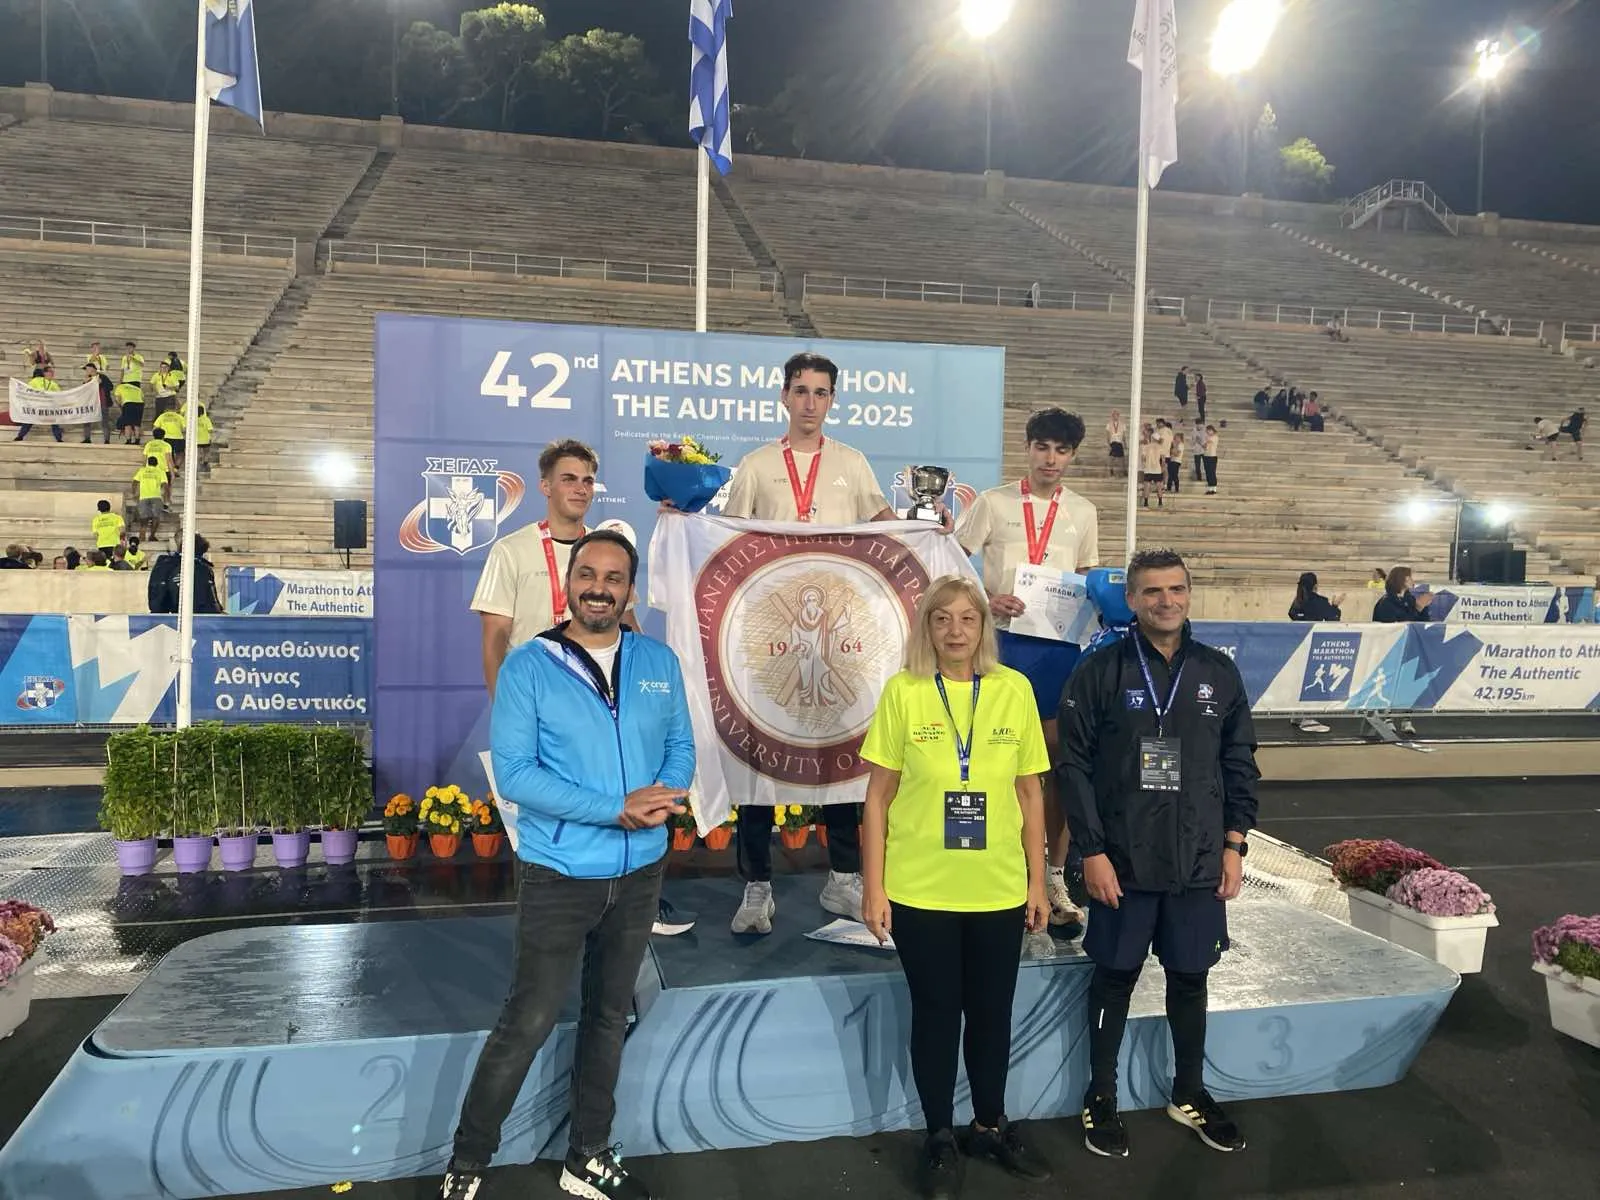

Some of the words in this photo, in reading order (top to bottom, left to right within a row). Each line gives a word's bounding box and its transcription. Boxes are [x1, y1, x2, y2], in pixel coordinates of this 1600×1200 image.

[611, 358, 732, 387] ATHENS
[740, 364, 915, 394] MAHON.
[38, 408, 73, 416] RUNNING
[612, 393, 670, 418] THE
[677, 396, 840, 425] AUTHENC
[847, 403, 913, 427] 2025
[614, 429, 650, 438] Dedicated
[425, 457, 498, 474] ΣΕΓΑΣ
[287, 583, 339, 596] Marathon
[343, 586, 354, 596] to
[287, 600, 307, 611] The
[310, 601, 365, 613] Authentic
[1461, 597, 1513, 607] Marathon
[1516, 599, 1527, 607] to
[1461, 610, 1480, 620] The
[212, 640, 360, 662] Μαραθώνιος
[768, 641, 787, 656] 19
[841, 636, 862, 653] 64
[1321, 640, 1350, 648] ATHENS
[1484, 643, 1556, 658] Marathon
[1560, 645, 1573, 658] to
[214, 667, 300, 688] Αθήνας
[1480, 665, 1507, 679] The
[1510, 665, 1582, 680] Authentic
[216, 694, 234, 711] Ο
[241, 693, 366, 713] Αυθεντικός
[1255, 1014, 1294, 1077] 3
[359, 1054, 409, 1128] 2
